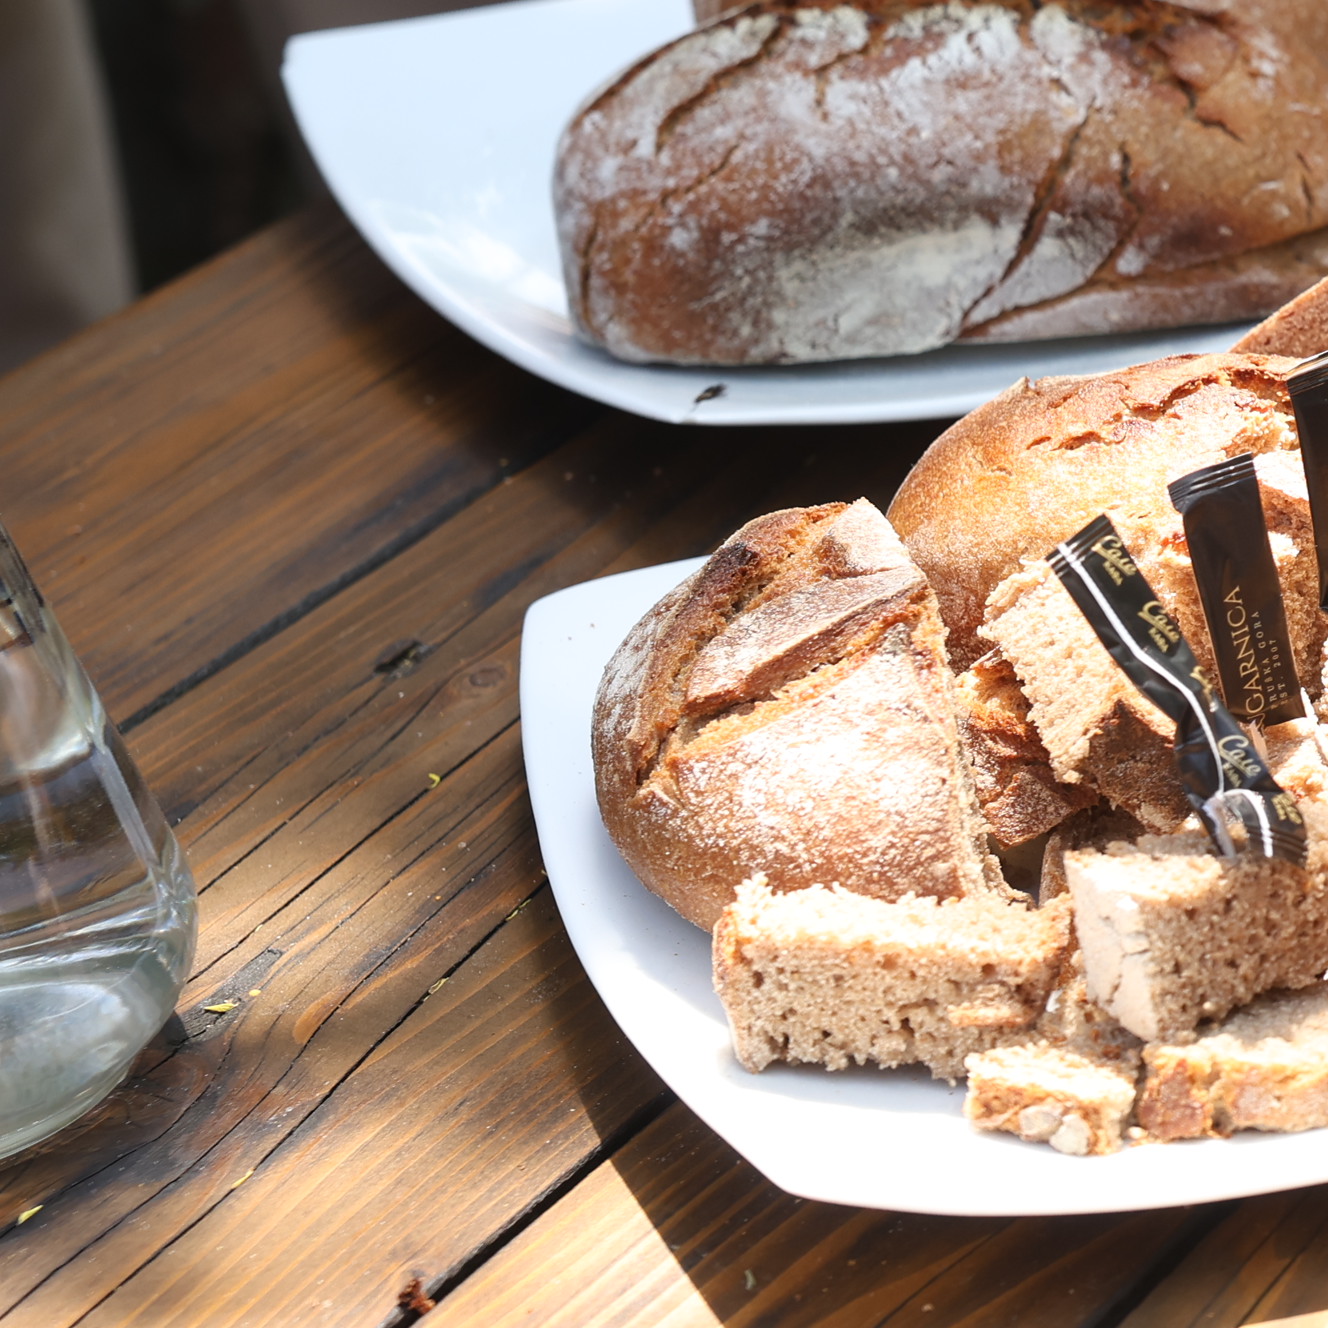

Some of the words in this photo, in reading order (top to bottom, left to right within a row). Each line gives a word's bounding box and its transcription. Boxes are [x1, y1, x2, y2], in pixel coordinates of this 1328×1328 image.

[1251, 611, 1267, 649] GORA
[1223, 585, 1266, 731] UGARNICA
[1269, 639, 1281, 669] 2007
